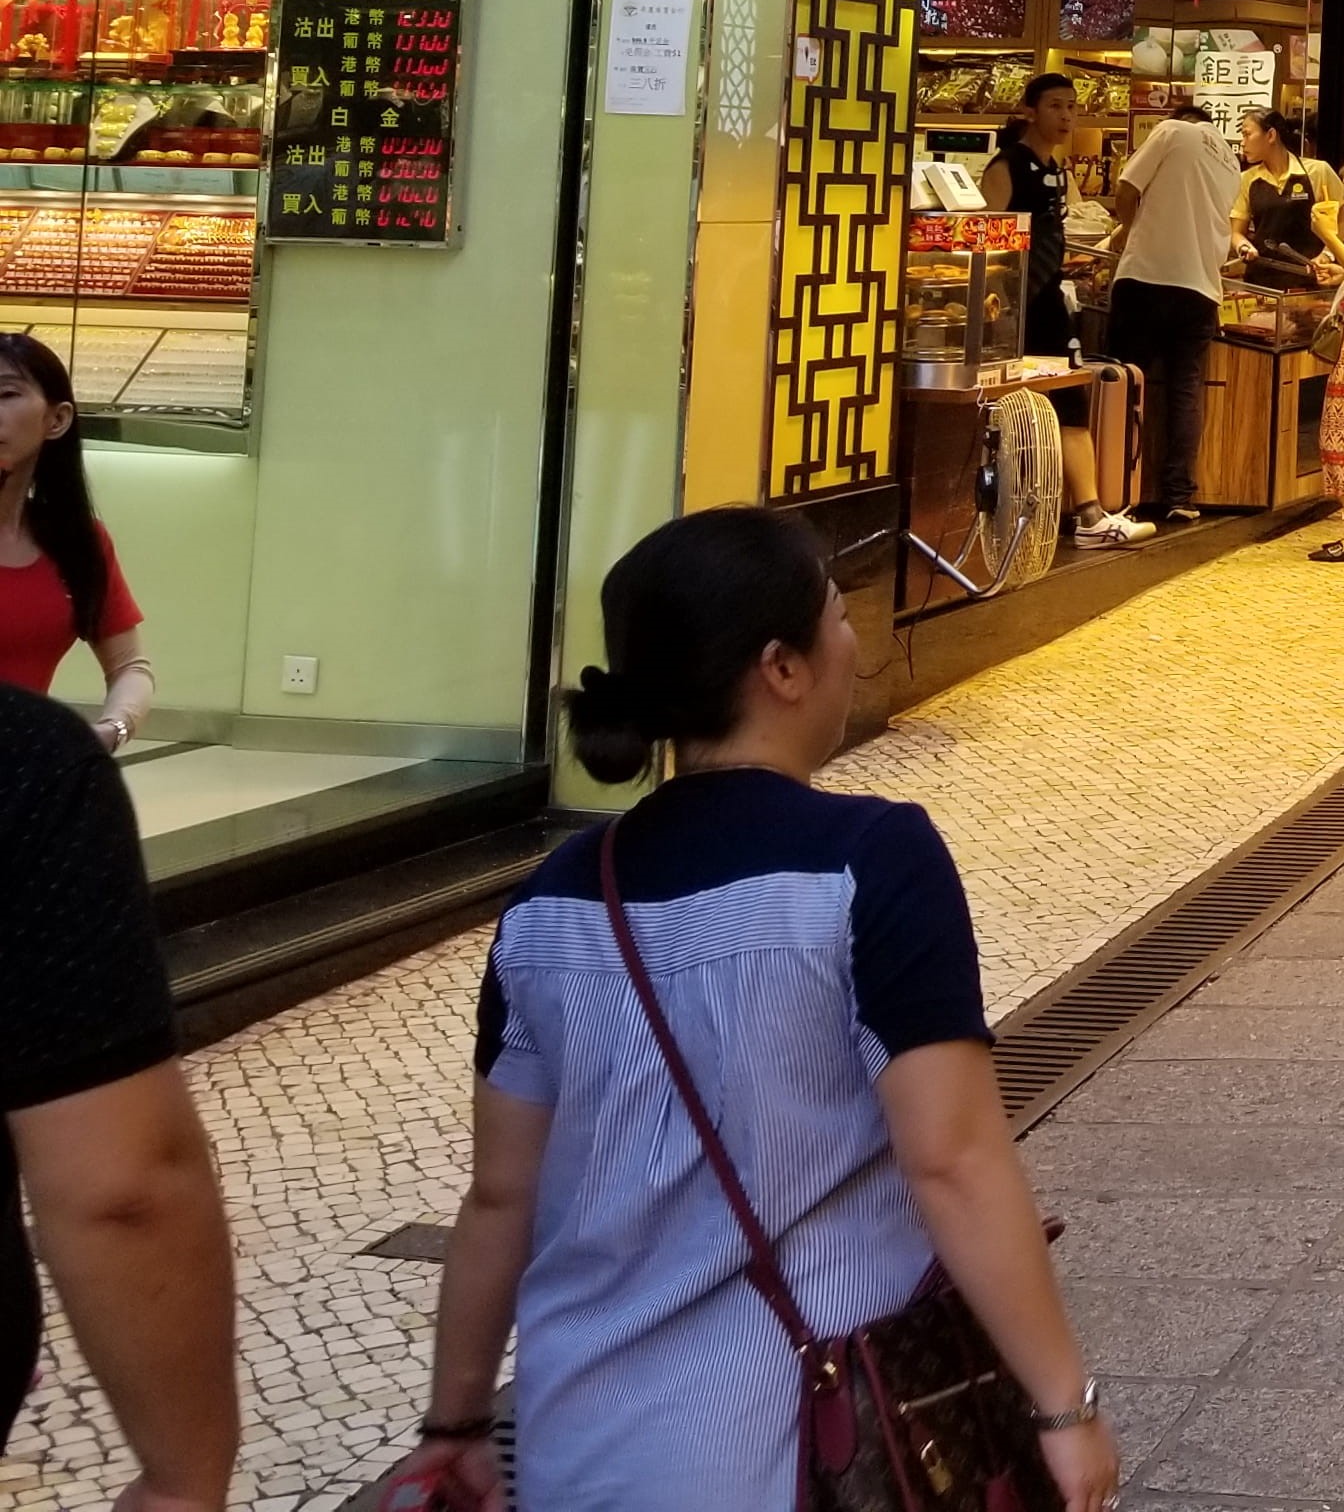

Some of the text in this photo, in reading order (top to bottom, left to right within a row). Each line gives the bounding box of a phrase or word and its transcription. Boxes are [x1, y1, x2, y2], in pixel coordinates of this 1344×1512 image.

[294, 17, 334, 38] 沽出
[344, 9, 384, 26] 港幣
[340, 56, 381, 73] 港幣
[1202, 56, 1270, 85] 鉅記
[291, 66, 330, 87] 買入
[335, 136, 375, 153] 港幣
[286, 145, 325, 166] 沽出
[282, 193, 323, 214] 買入
[332, 184, 372, 202] 港幣
